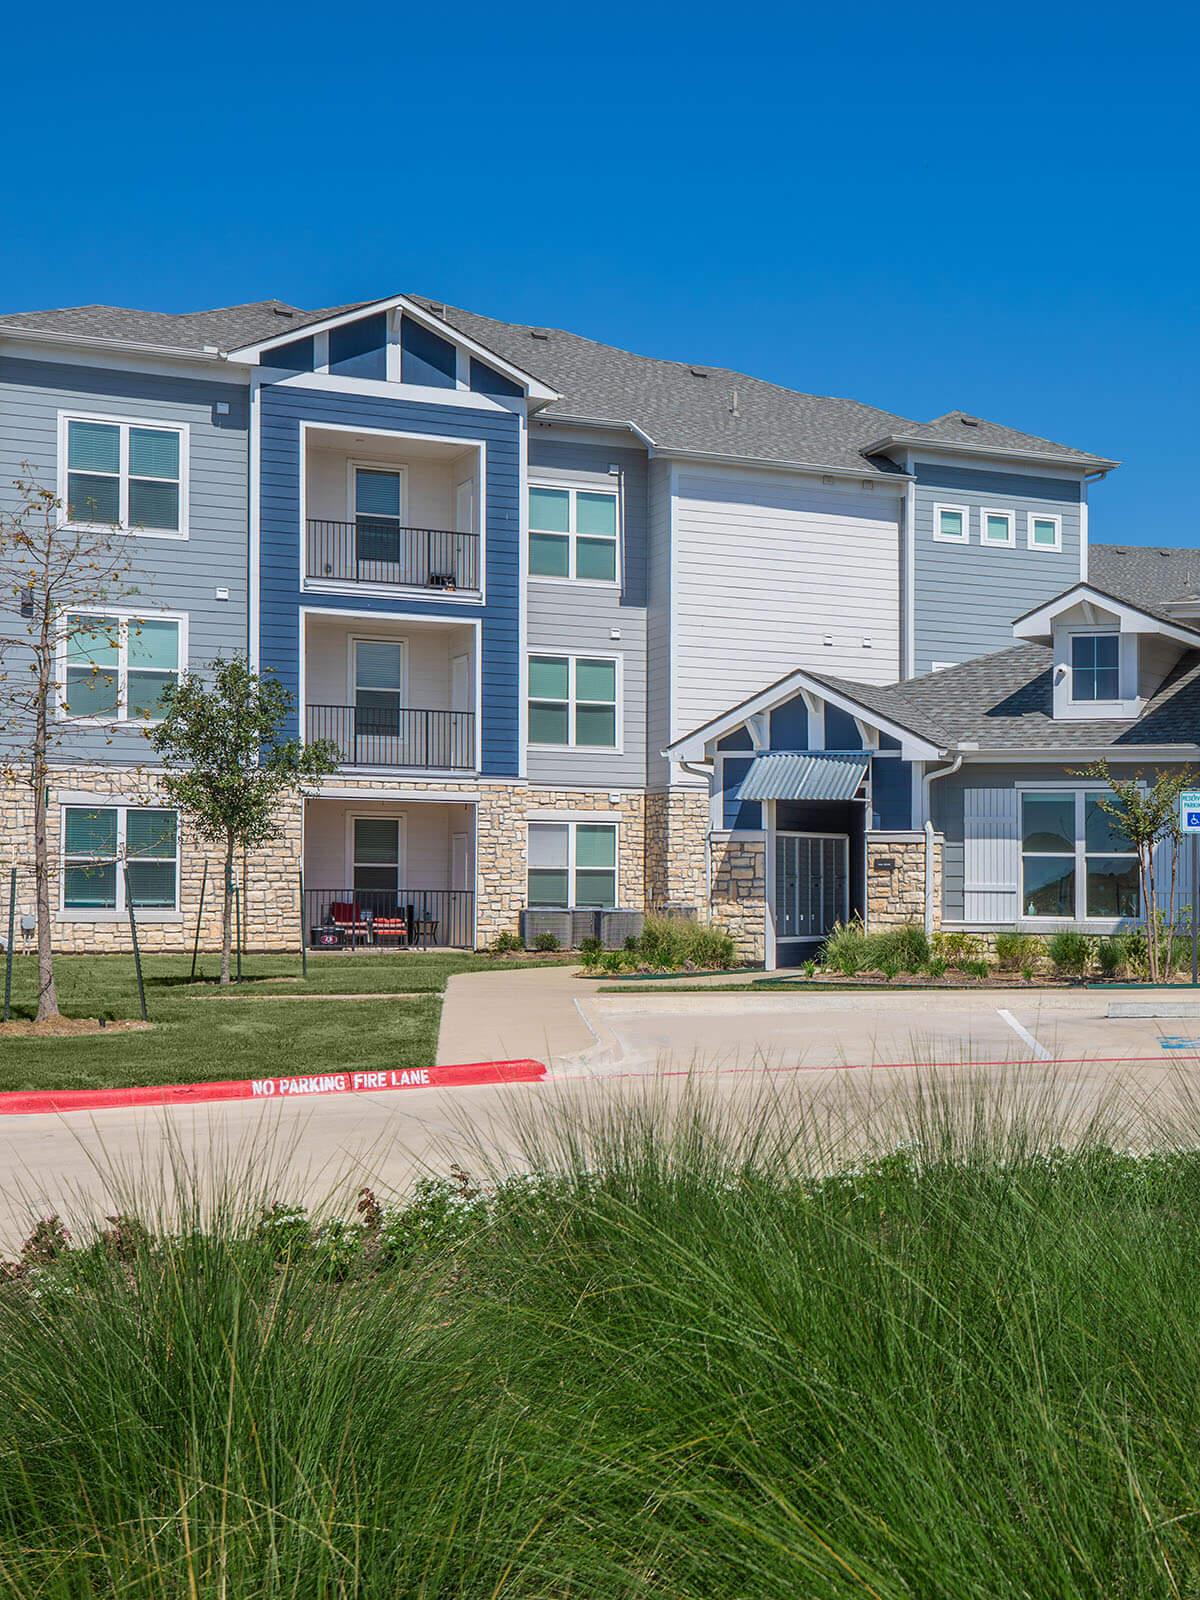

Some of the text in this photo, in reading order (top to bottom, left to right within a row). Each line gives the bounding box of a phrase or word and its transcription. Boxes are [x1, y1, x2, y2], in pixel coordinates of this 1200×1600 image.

[251, 1069, 431, 1096] NO PARKING FIRE LANE
